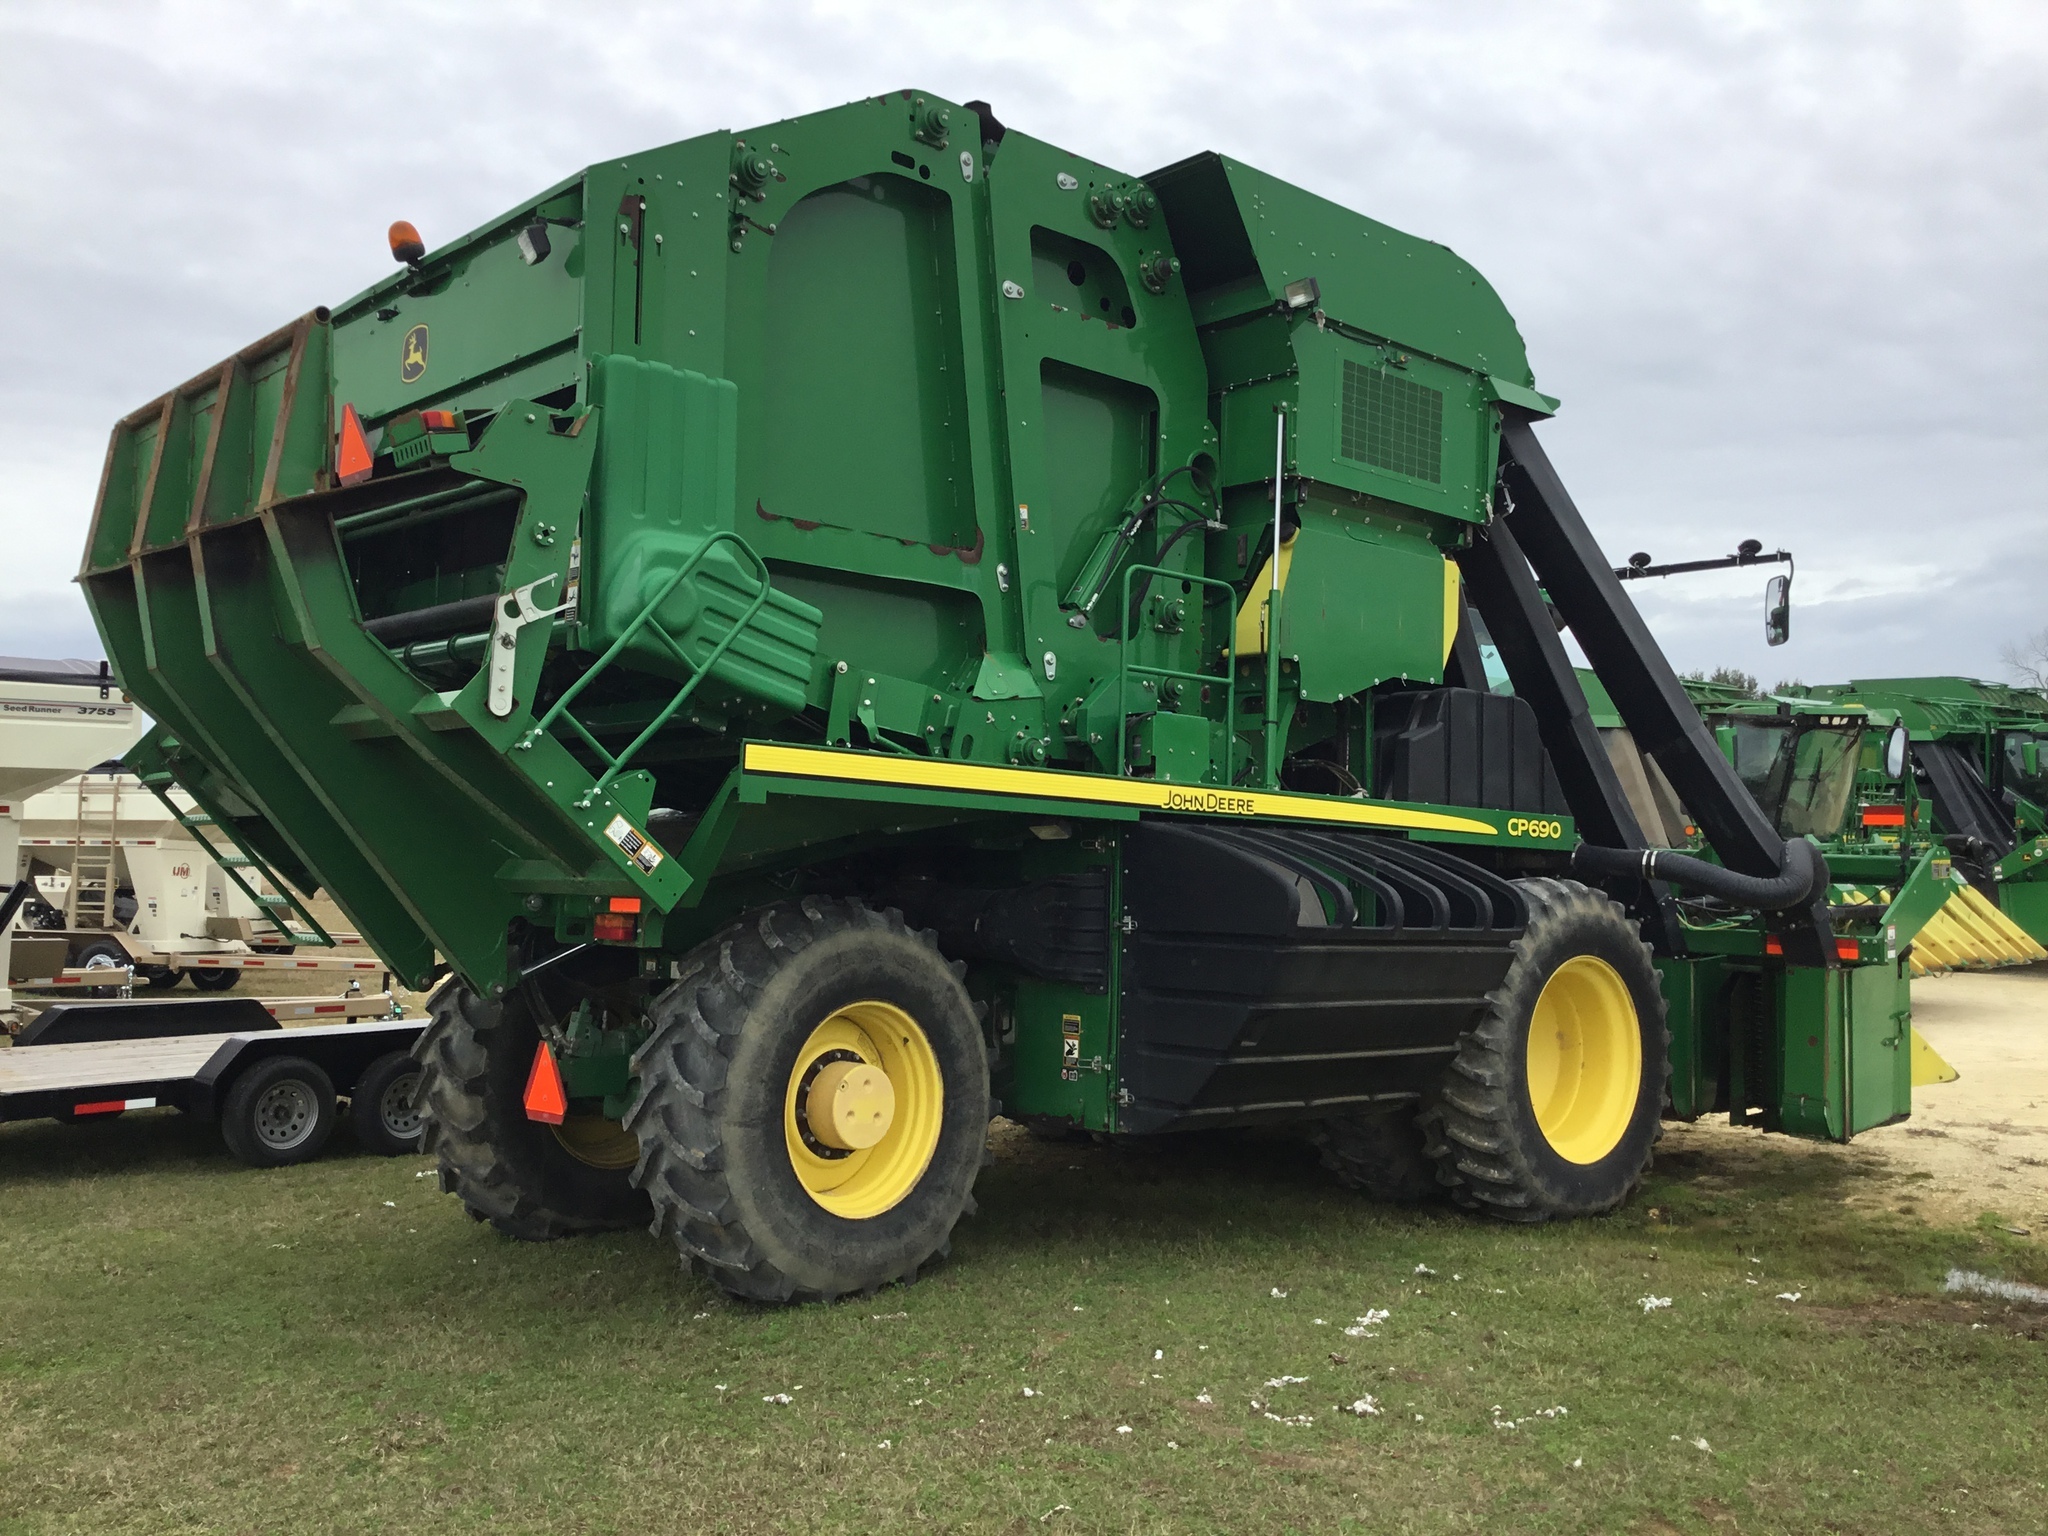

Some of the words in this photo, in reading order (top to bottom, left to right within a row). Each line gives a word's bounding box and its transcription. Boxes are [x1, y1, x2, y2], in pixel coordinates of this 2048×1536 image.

[3, 704, 27, 713] Seed
[28, 705, 62, 714] Runner
[77, 706, 116, 716] 3755
[1163, 790, 1204, 809] JOHN
[1206, 793, 1255, 813] DEERE
[1507, 817, 1562, 839] CP690
